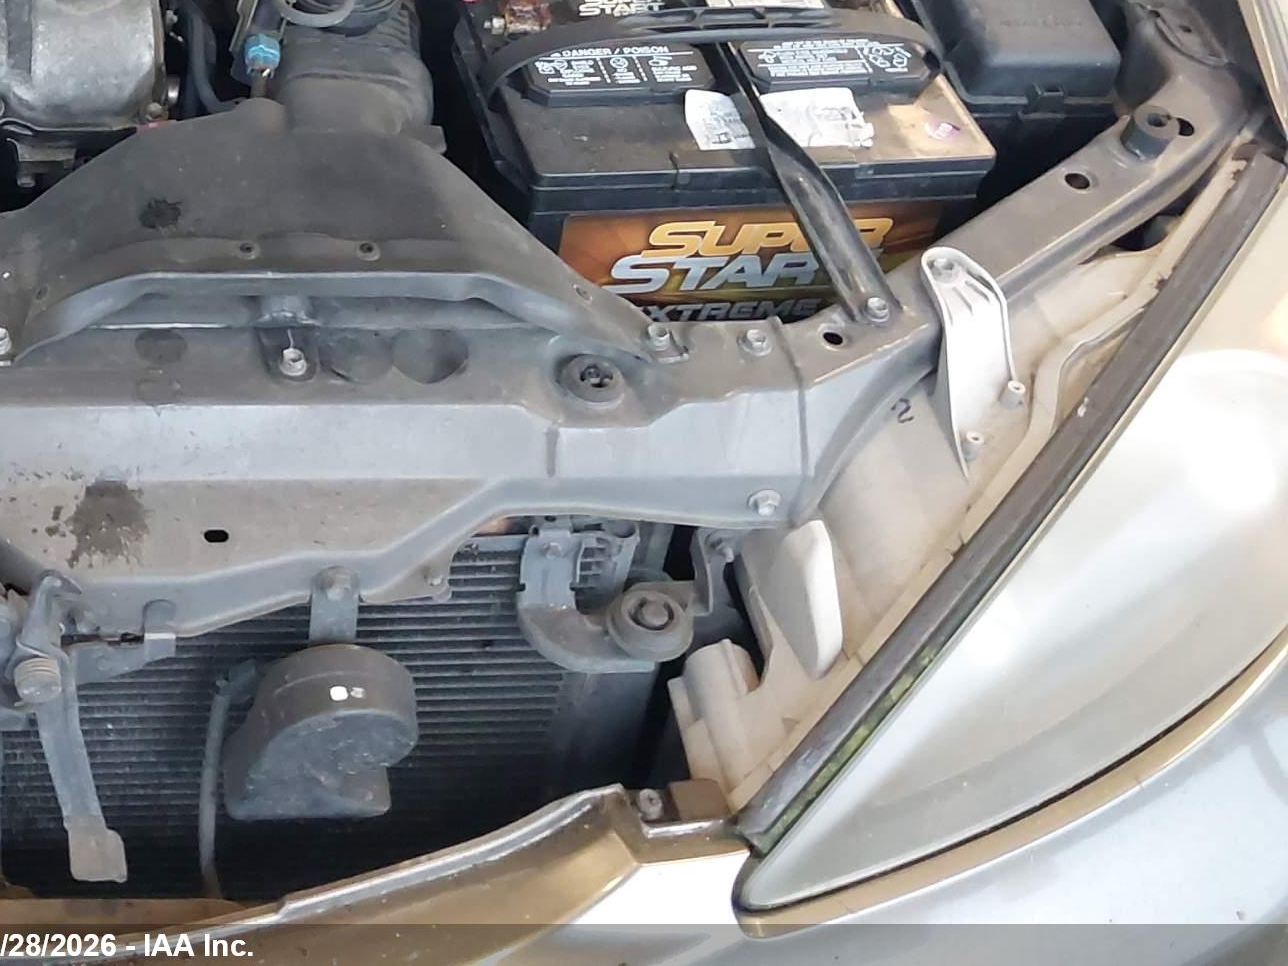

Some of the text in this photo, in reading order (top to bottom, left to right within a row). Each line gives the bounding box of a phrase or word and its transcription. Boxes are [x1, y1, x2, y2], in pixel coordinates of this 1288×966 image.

[561, 47, 612, 57] DANGER
[622, 45, 670, 54] POISON
[602, 251, 820, 294] STAR
